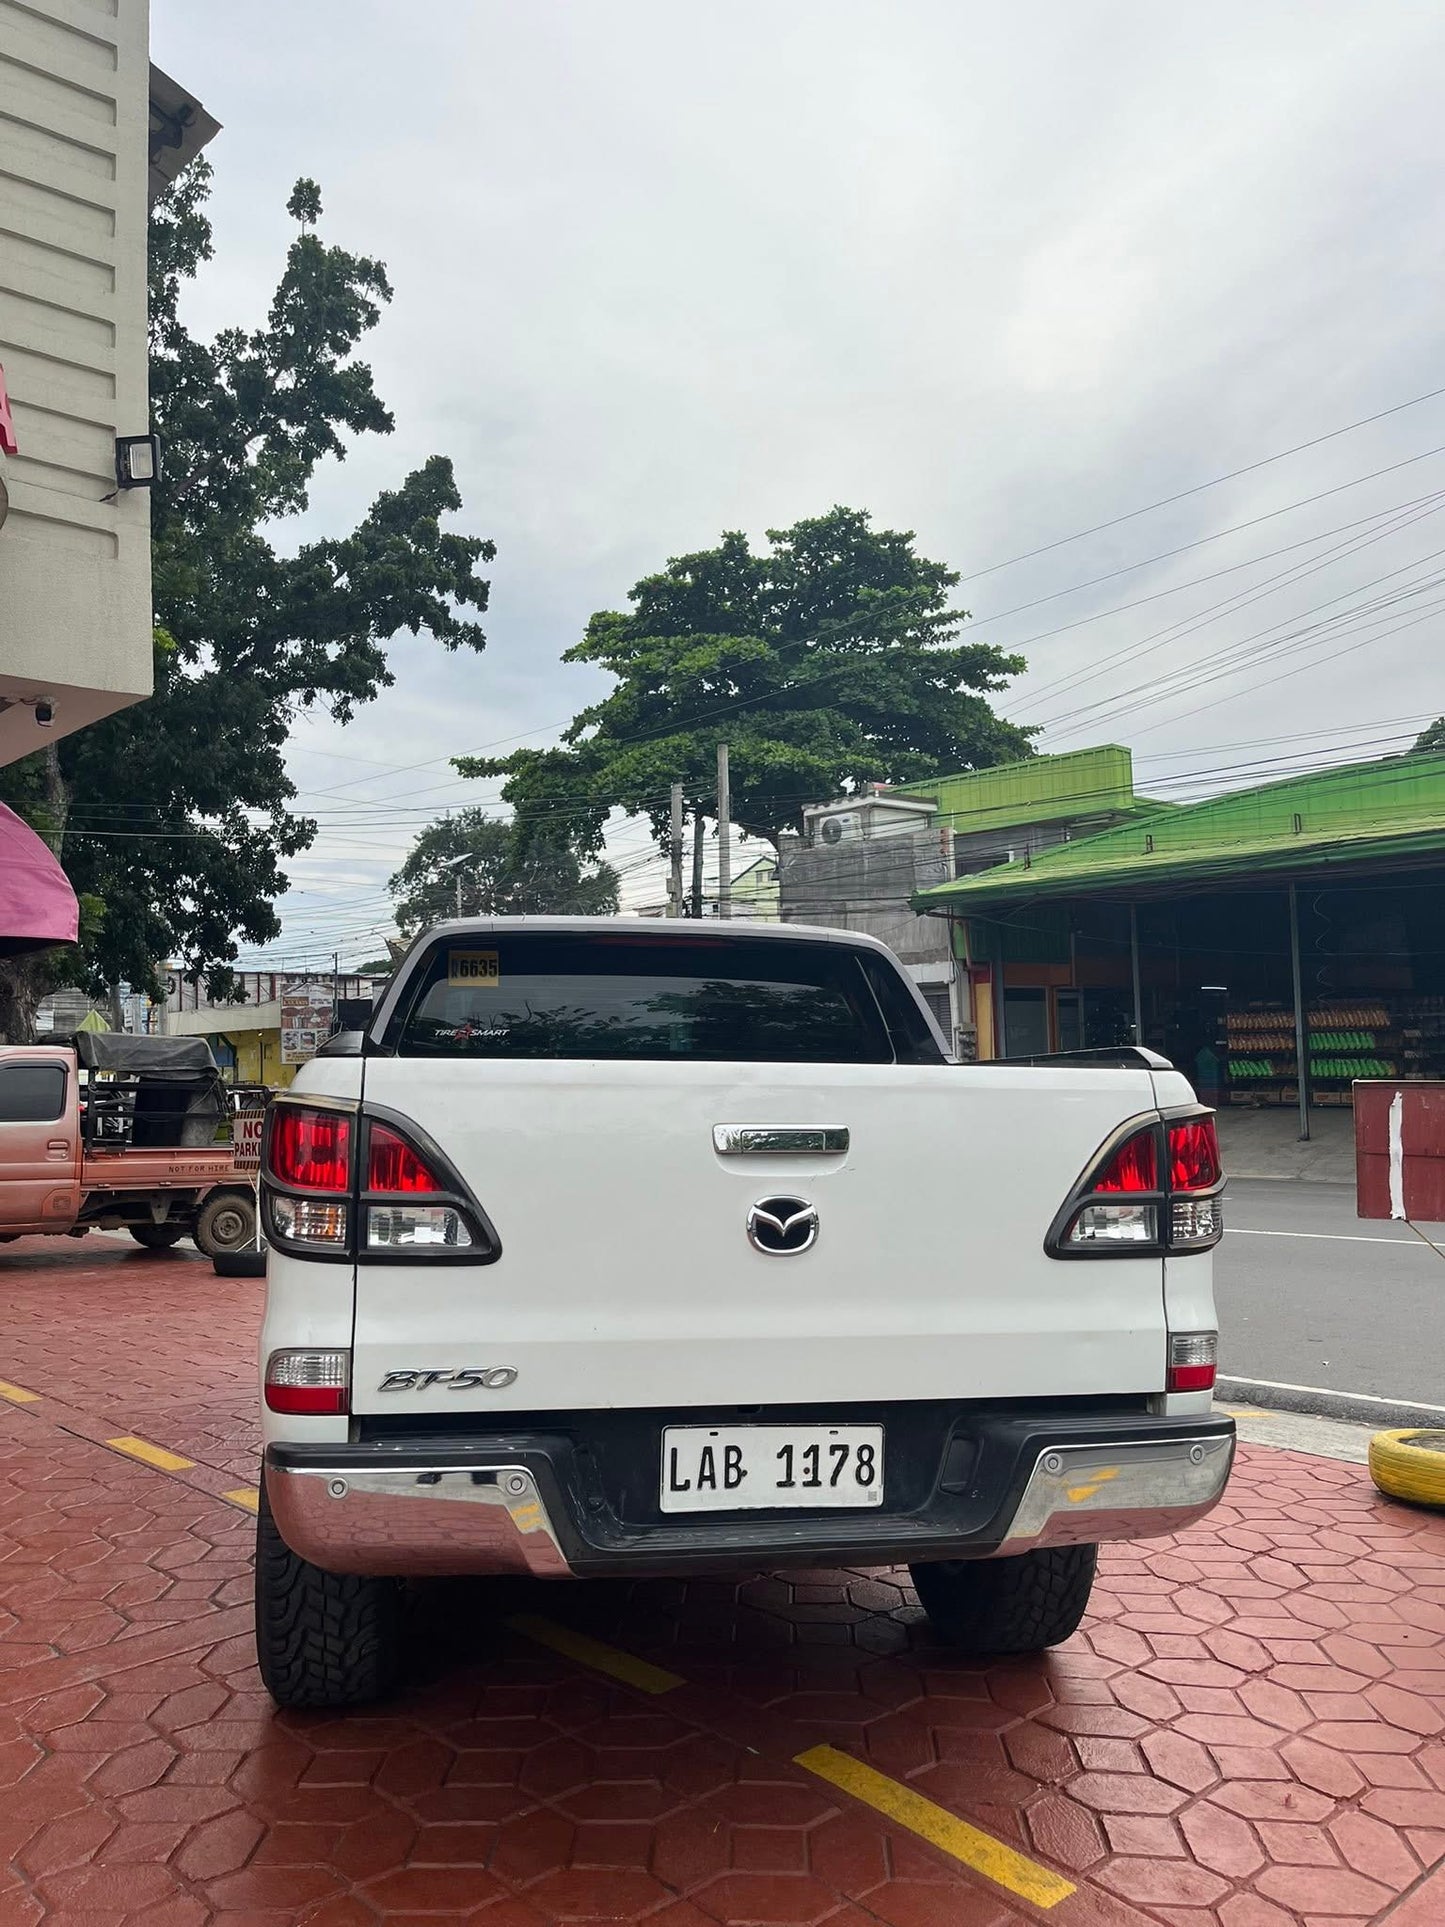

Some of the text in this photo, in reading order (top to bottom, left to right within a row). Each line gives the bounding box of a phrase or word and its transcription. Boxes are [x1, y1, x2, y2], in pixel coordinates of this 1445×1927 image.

[460, 959, 497, 977] 6635
[434, 1029, 511, 1037] TIRE SMART
[243, 1121, 263, 1138] NO
[168, 1164, 230, 1173] NOT FOR HIRE
[376, 1365, 519, 1393] BT-50
[670, 1444, 875, 1491] LAB 1178
